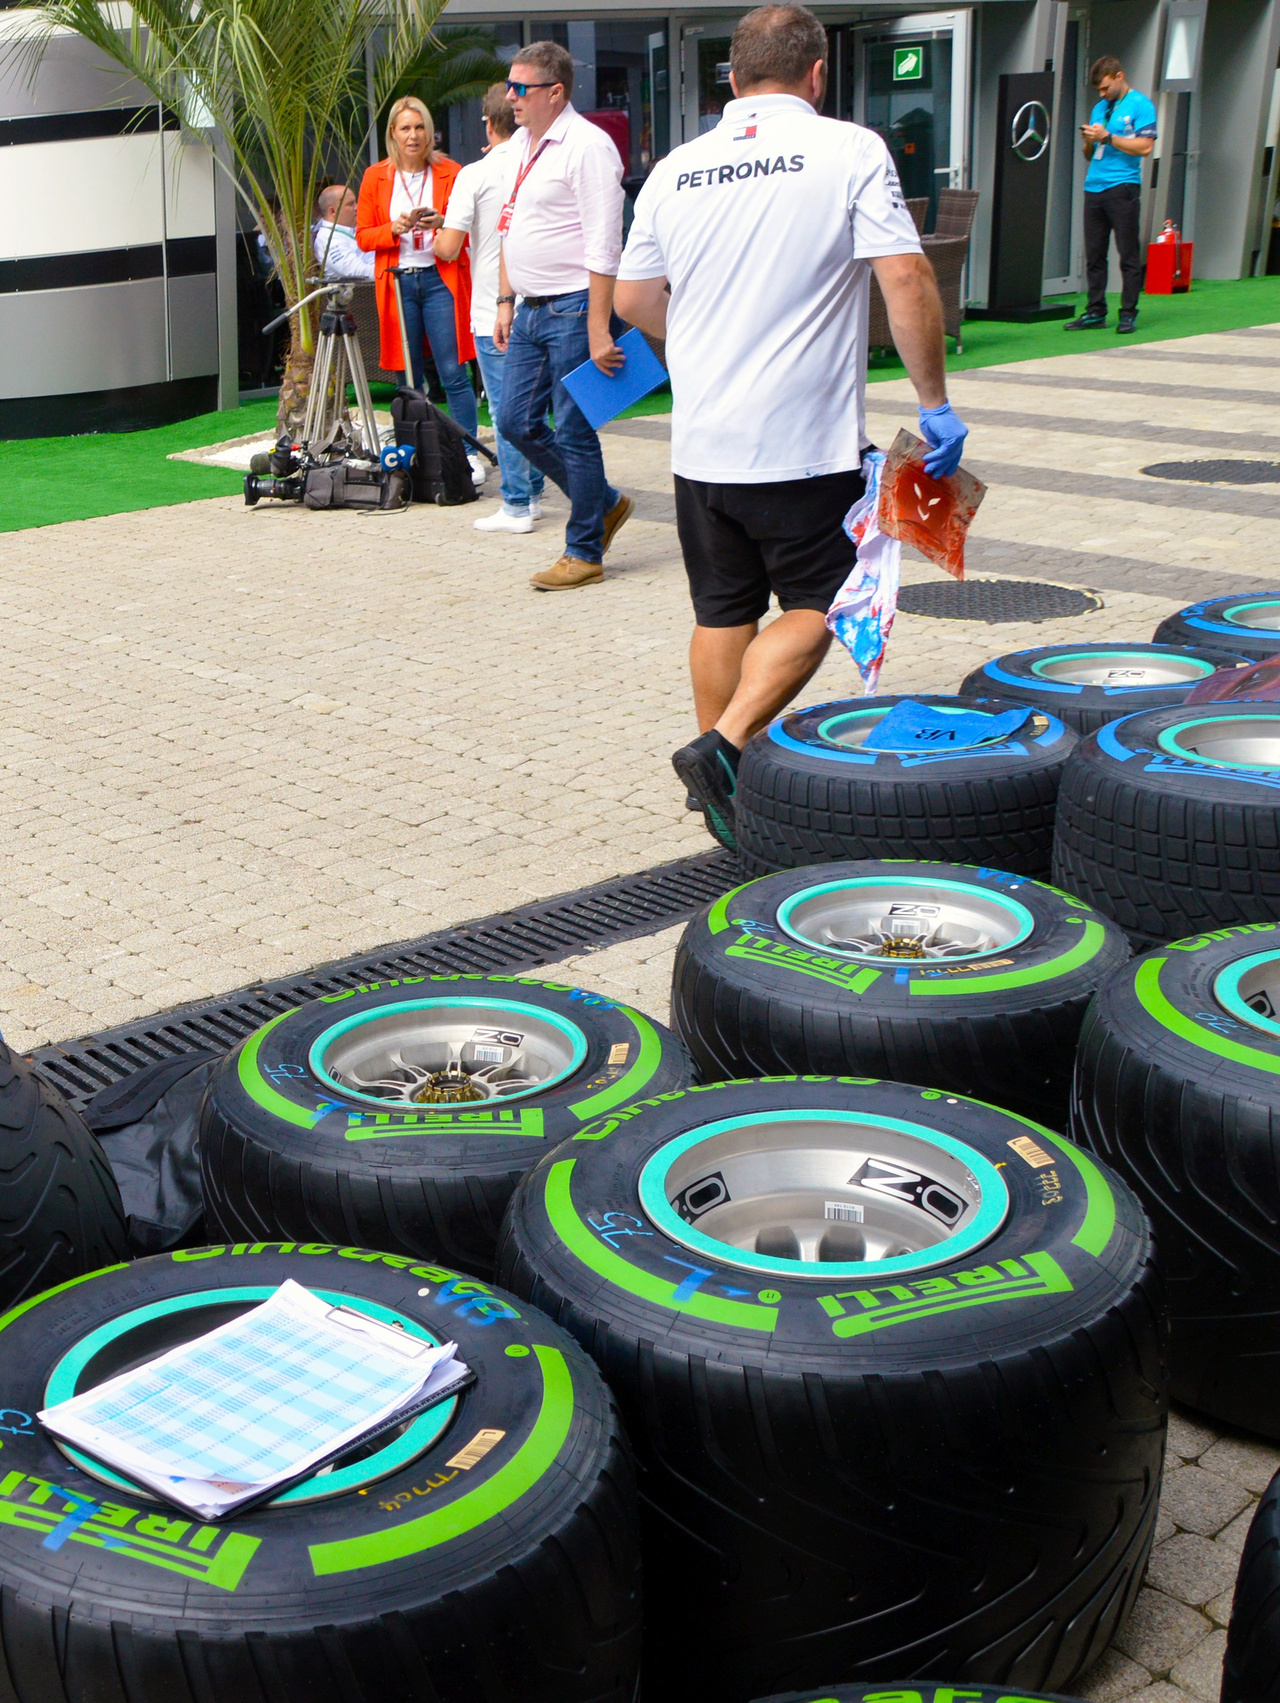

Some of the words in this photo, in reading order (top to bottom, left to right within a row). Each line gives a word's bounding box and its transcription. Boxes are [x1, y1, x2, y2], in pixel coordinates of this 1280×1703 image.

[676, 154, 805, 191] PETRONAS
[724, 934, 882, 995] PIRELLI
[345, 1107, 544, 1141] PIRELLI
[816, 1251, 1075, 1339] PIRELLI
